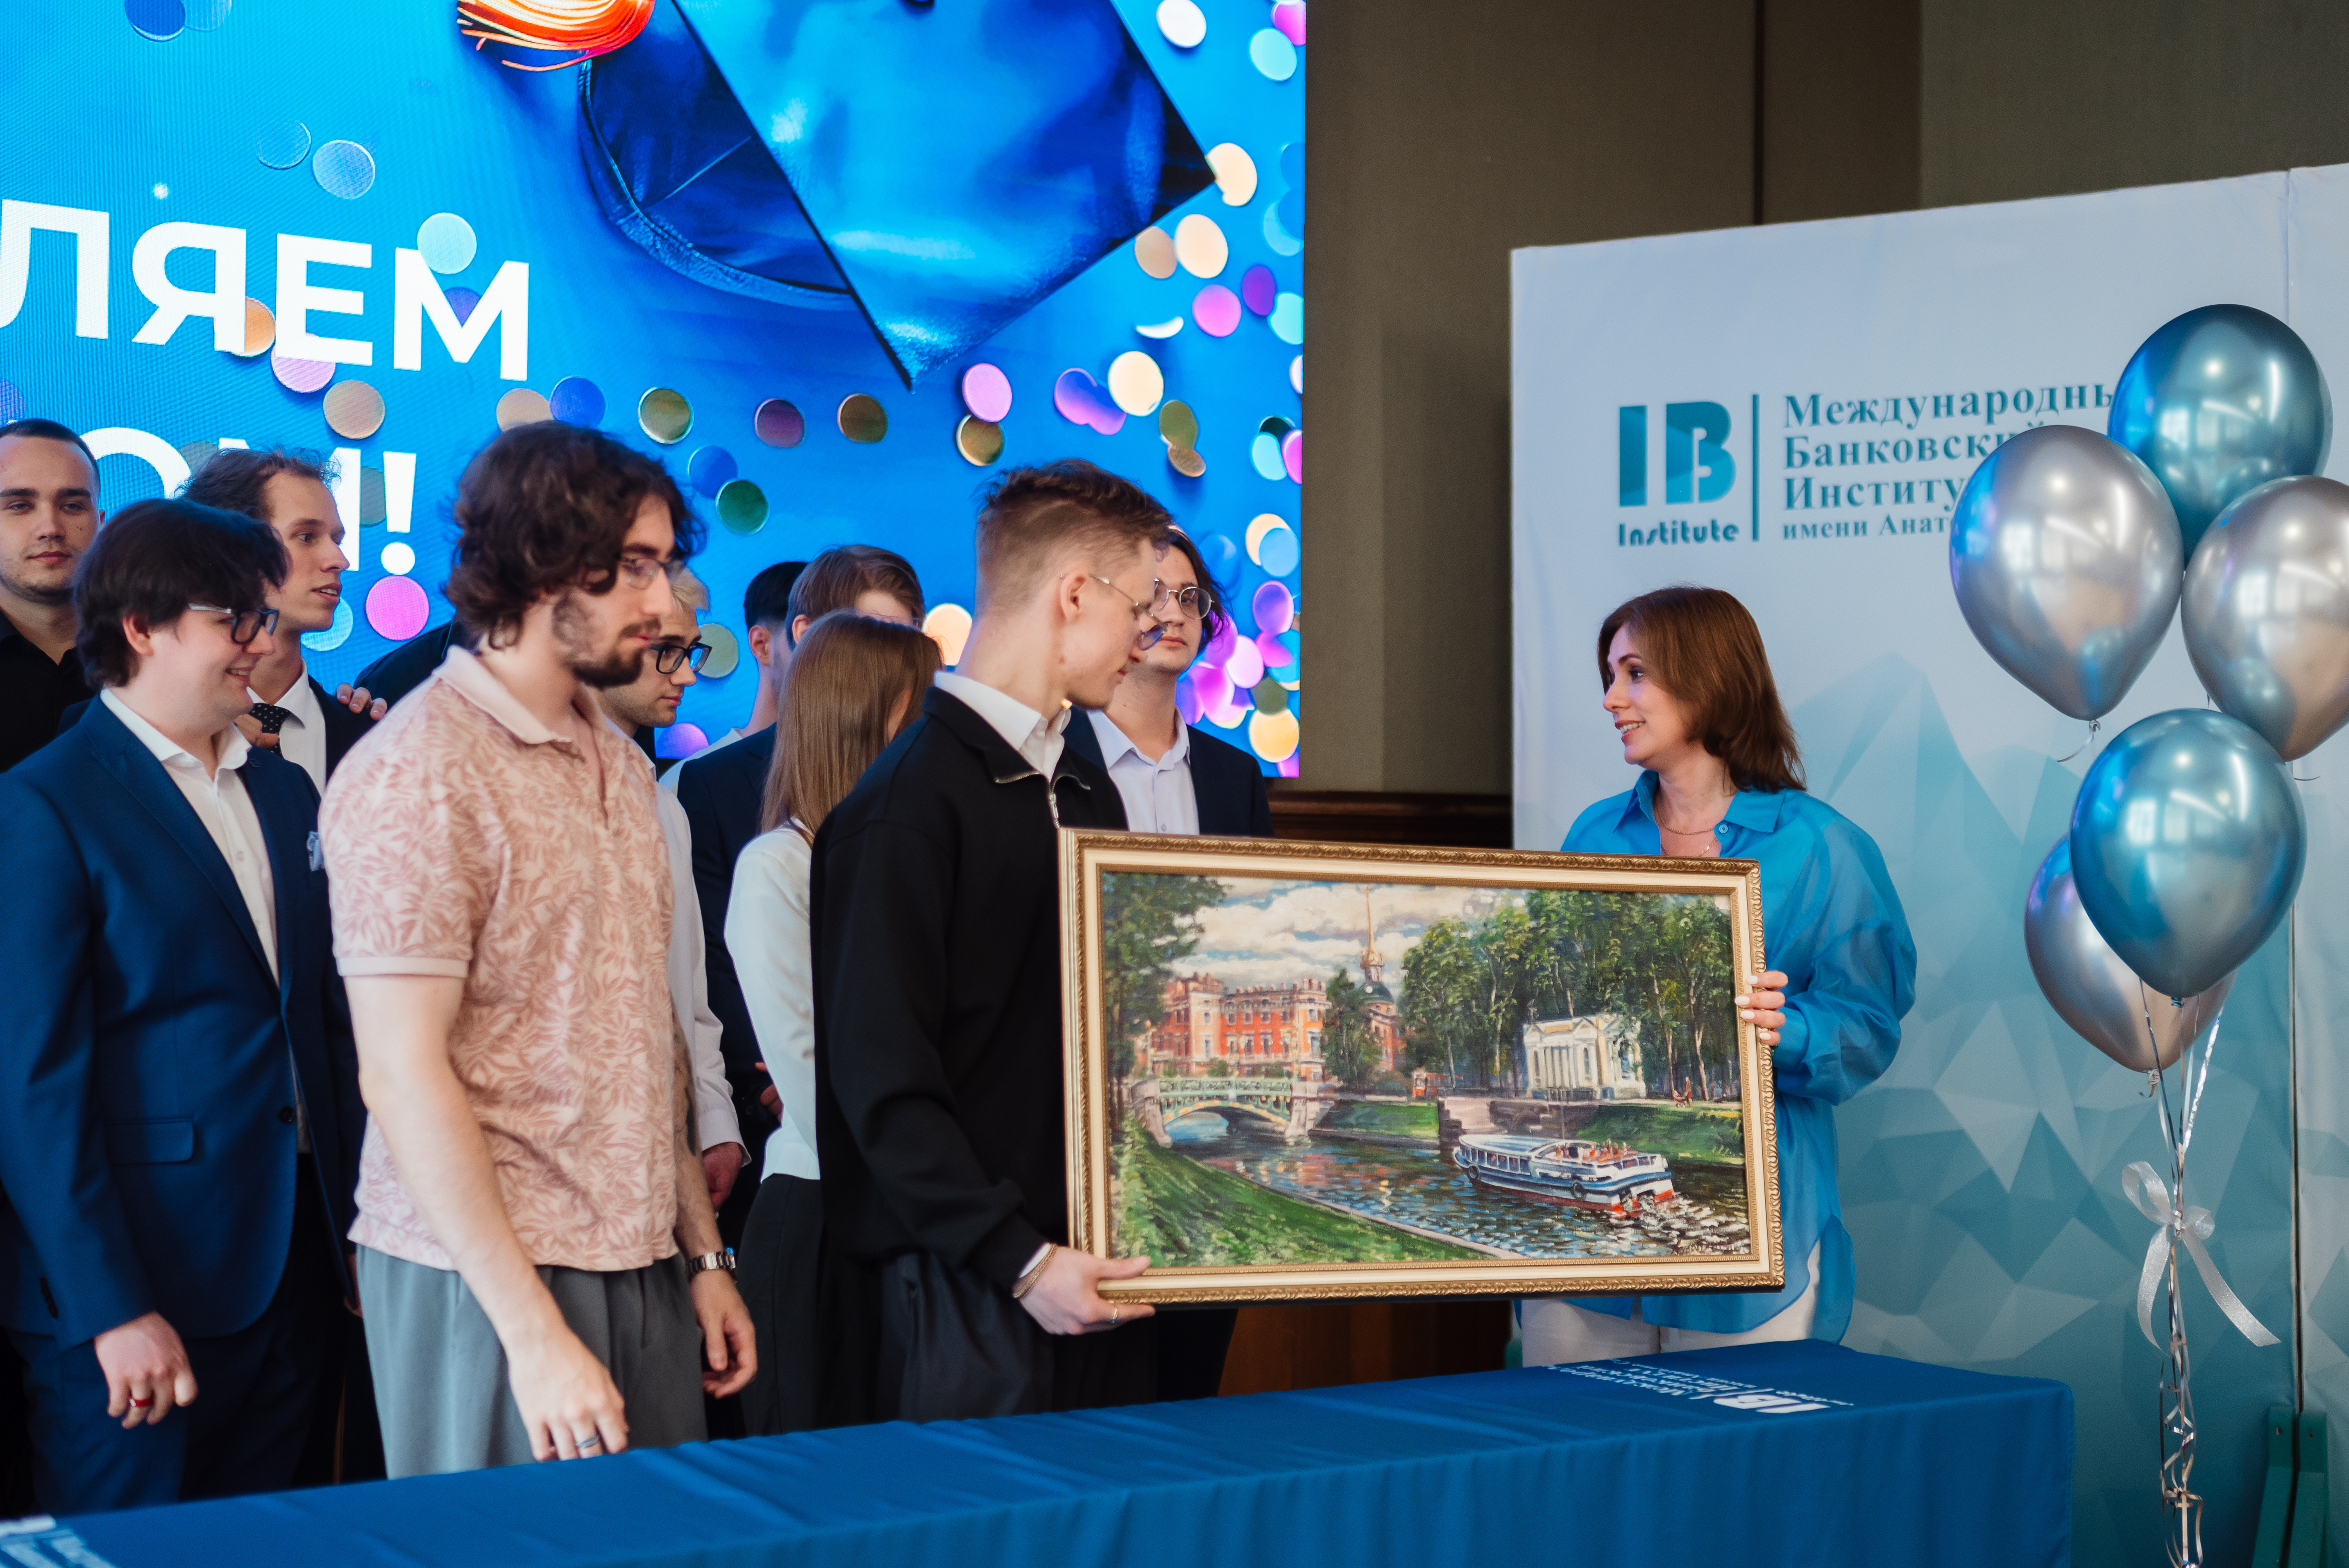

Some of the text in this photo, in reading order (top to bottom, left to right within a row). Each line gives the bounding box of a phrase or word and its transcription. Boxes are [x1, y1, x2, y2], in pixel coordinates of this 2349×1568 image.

[1619, 401, 1737, 507] IB
[1783, 421, 2044, 470] Банковск
[1783, 476, 1970, 513] Институ
[1619, 519, 1740, 547] Institute
[1783, 513, 1951, 540] имени Анат
